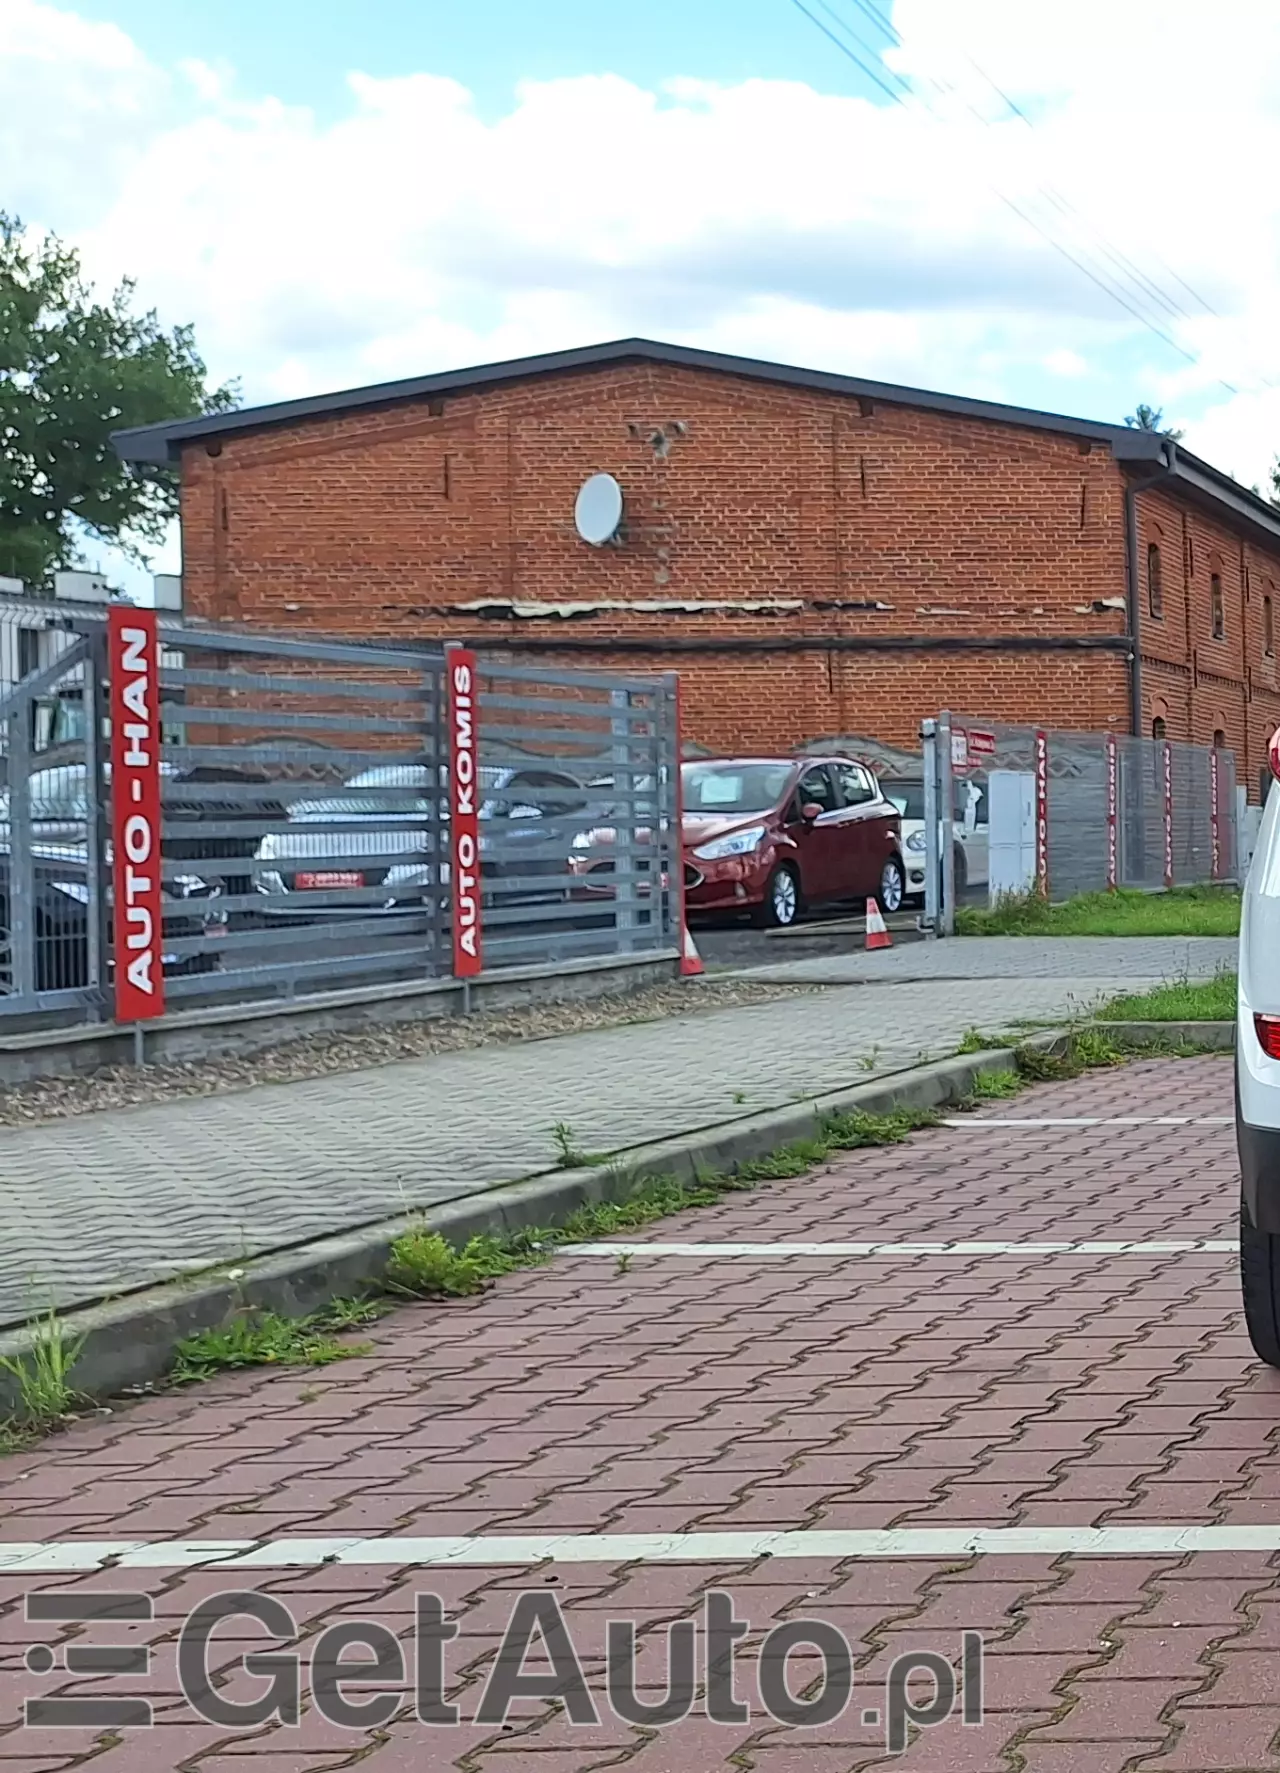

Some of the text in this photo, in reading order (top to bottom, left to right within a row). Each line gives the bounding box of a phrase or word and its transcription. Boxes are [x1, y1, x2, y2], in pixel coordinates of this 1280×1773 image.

[120, 626, 150, 767] HAN
[454, 664, 477, 958] AUTO KOMIS
[124, 814, 154, 996] AUTO
